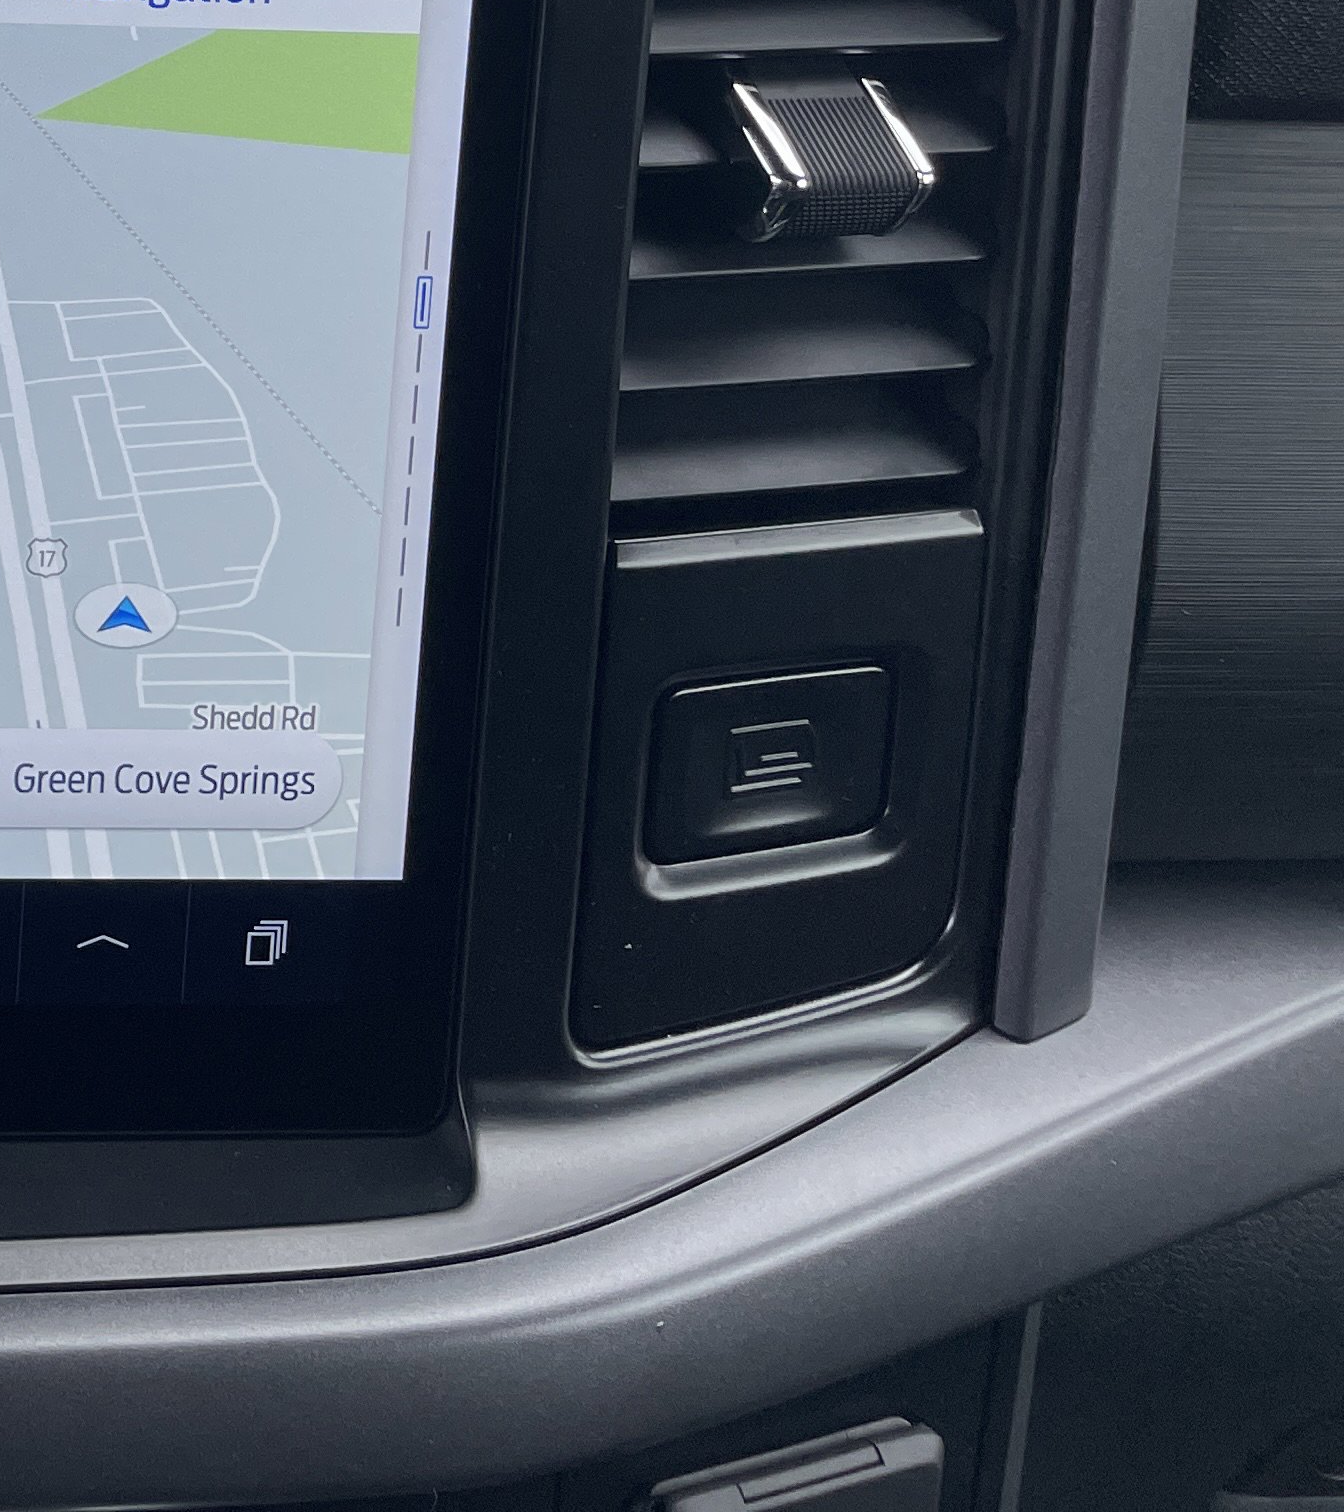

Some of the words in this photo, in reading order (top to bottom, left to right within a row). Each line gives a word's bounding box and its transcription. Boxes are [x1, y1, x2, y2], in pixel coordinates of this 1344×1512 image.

[39, 550, 56, 568] 17
[192, 704, 275, 731] Shedd
[281, 705, 316, 731] Rd
[14, 763, 105, 794] Green
[114, 763, 190, 794] Cove
[198, 764, 315, 801] Springs
